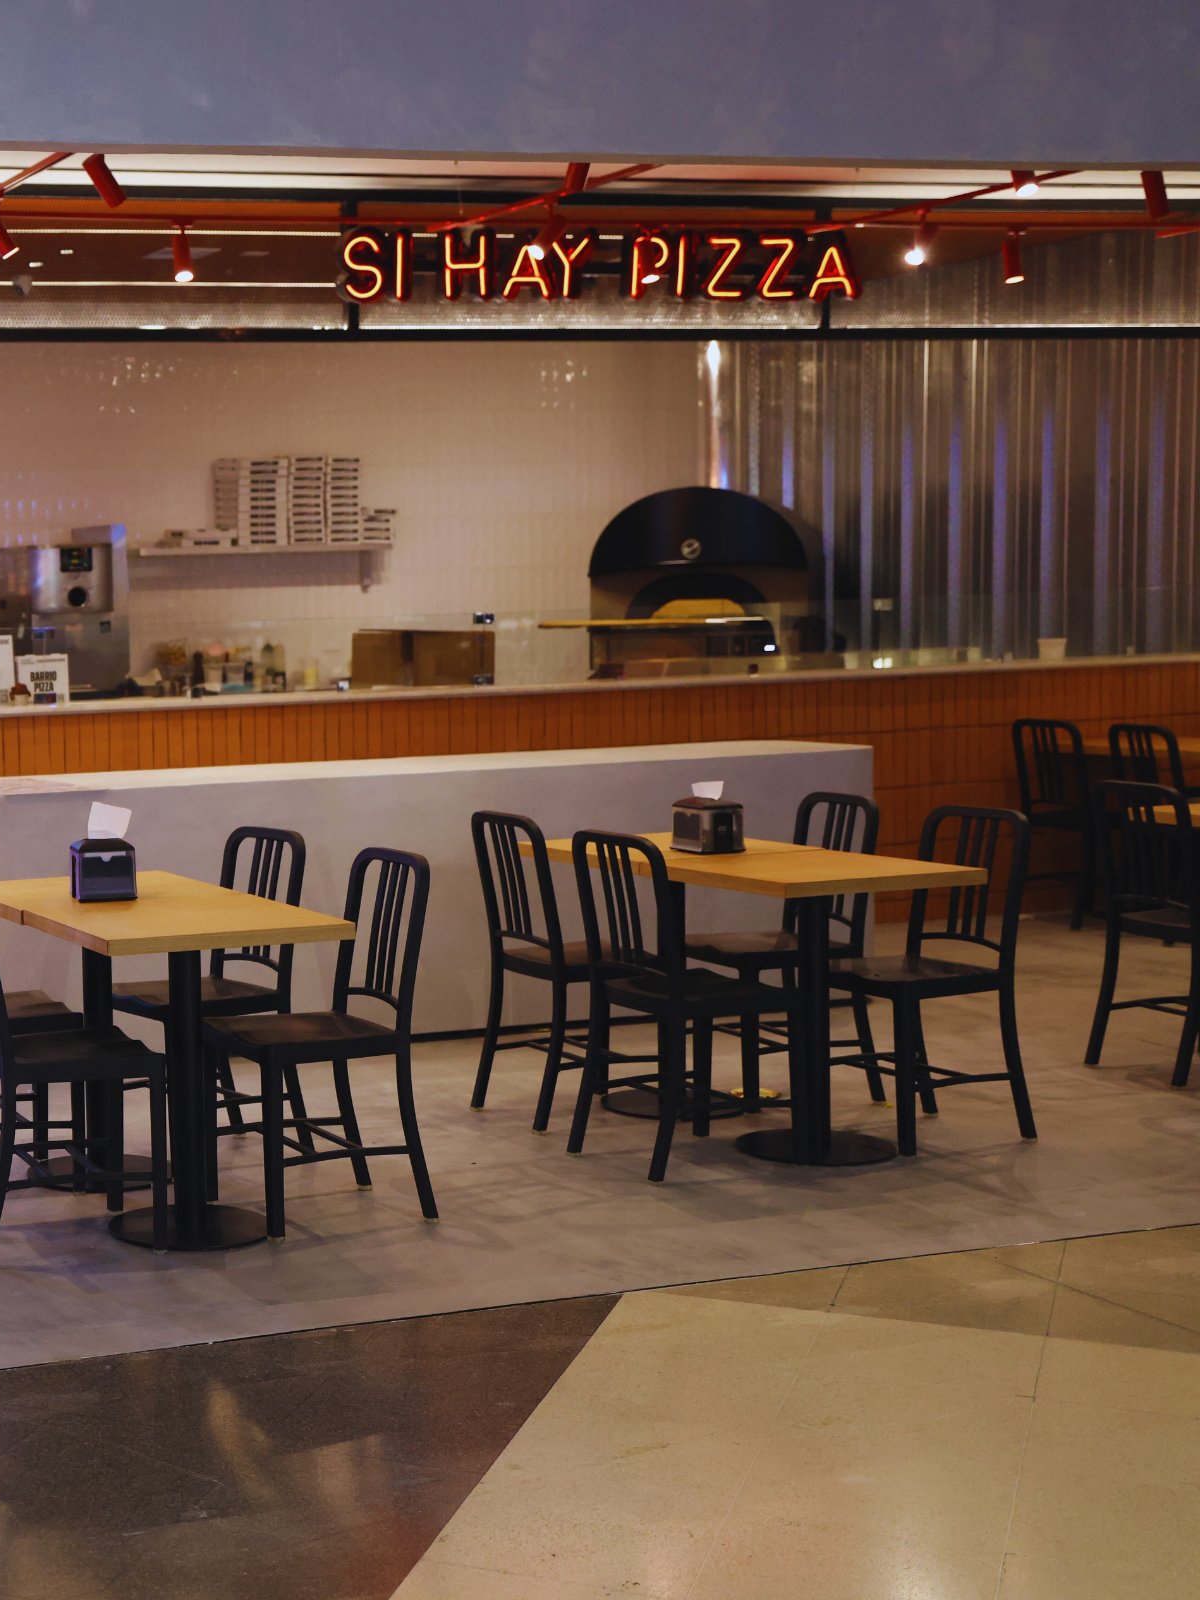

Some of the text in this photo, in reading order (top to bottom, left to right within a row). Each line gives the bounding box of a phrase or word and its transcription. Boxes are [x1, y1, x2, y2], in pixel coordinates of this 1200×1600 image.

[342, 232, 860, 300] SI HAY PIZZA
[30, 670, 57, 682] BARRIO
[34, 682, 54, 692] PIZZA
